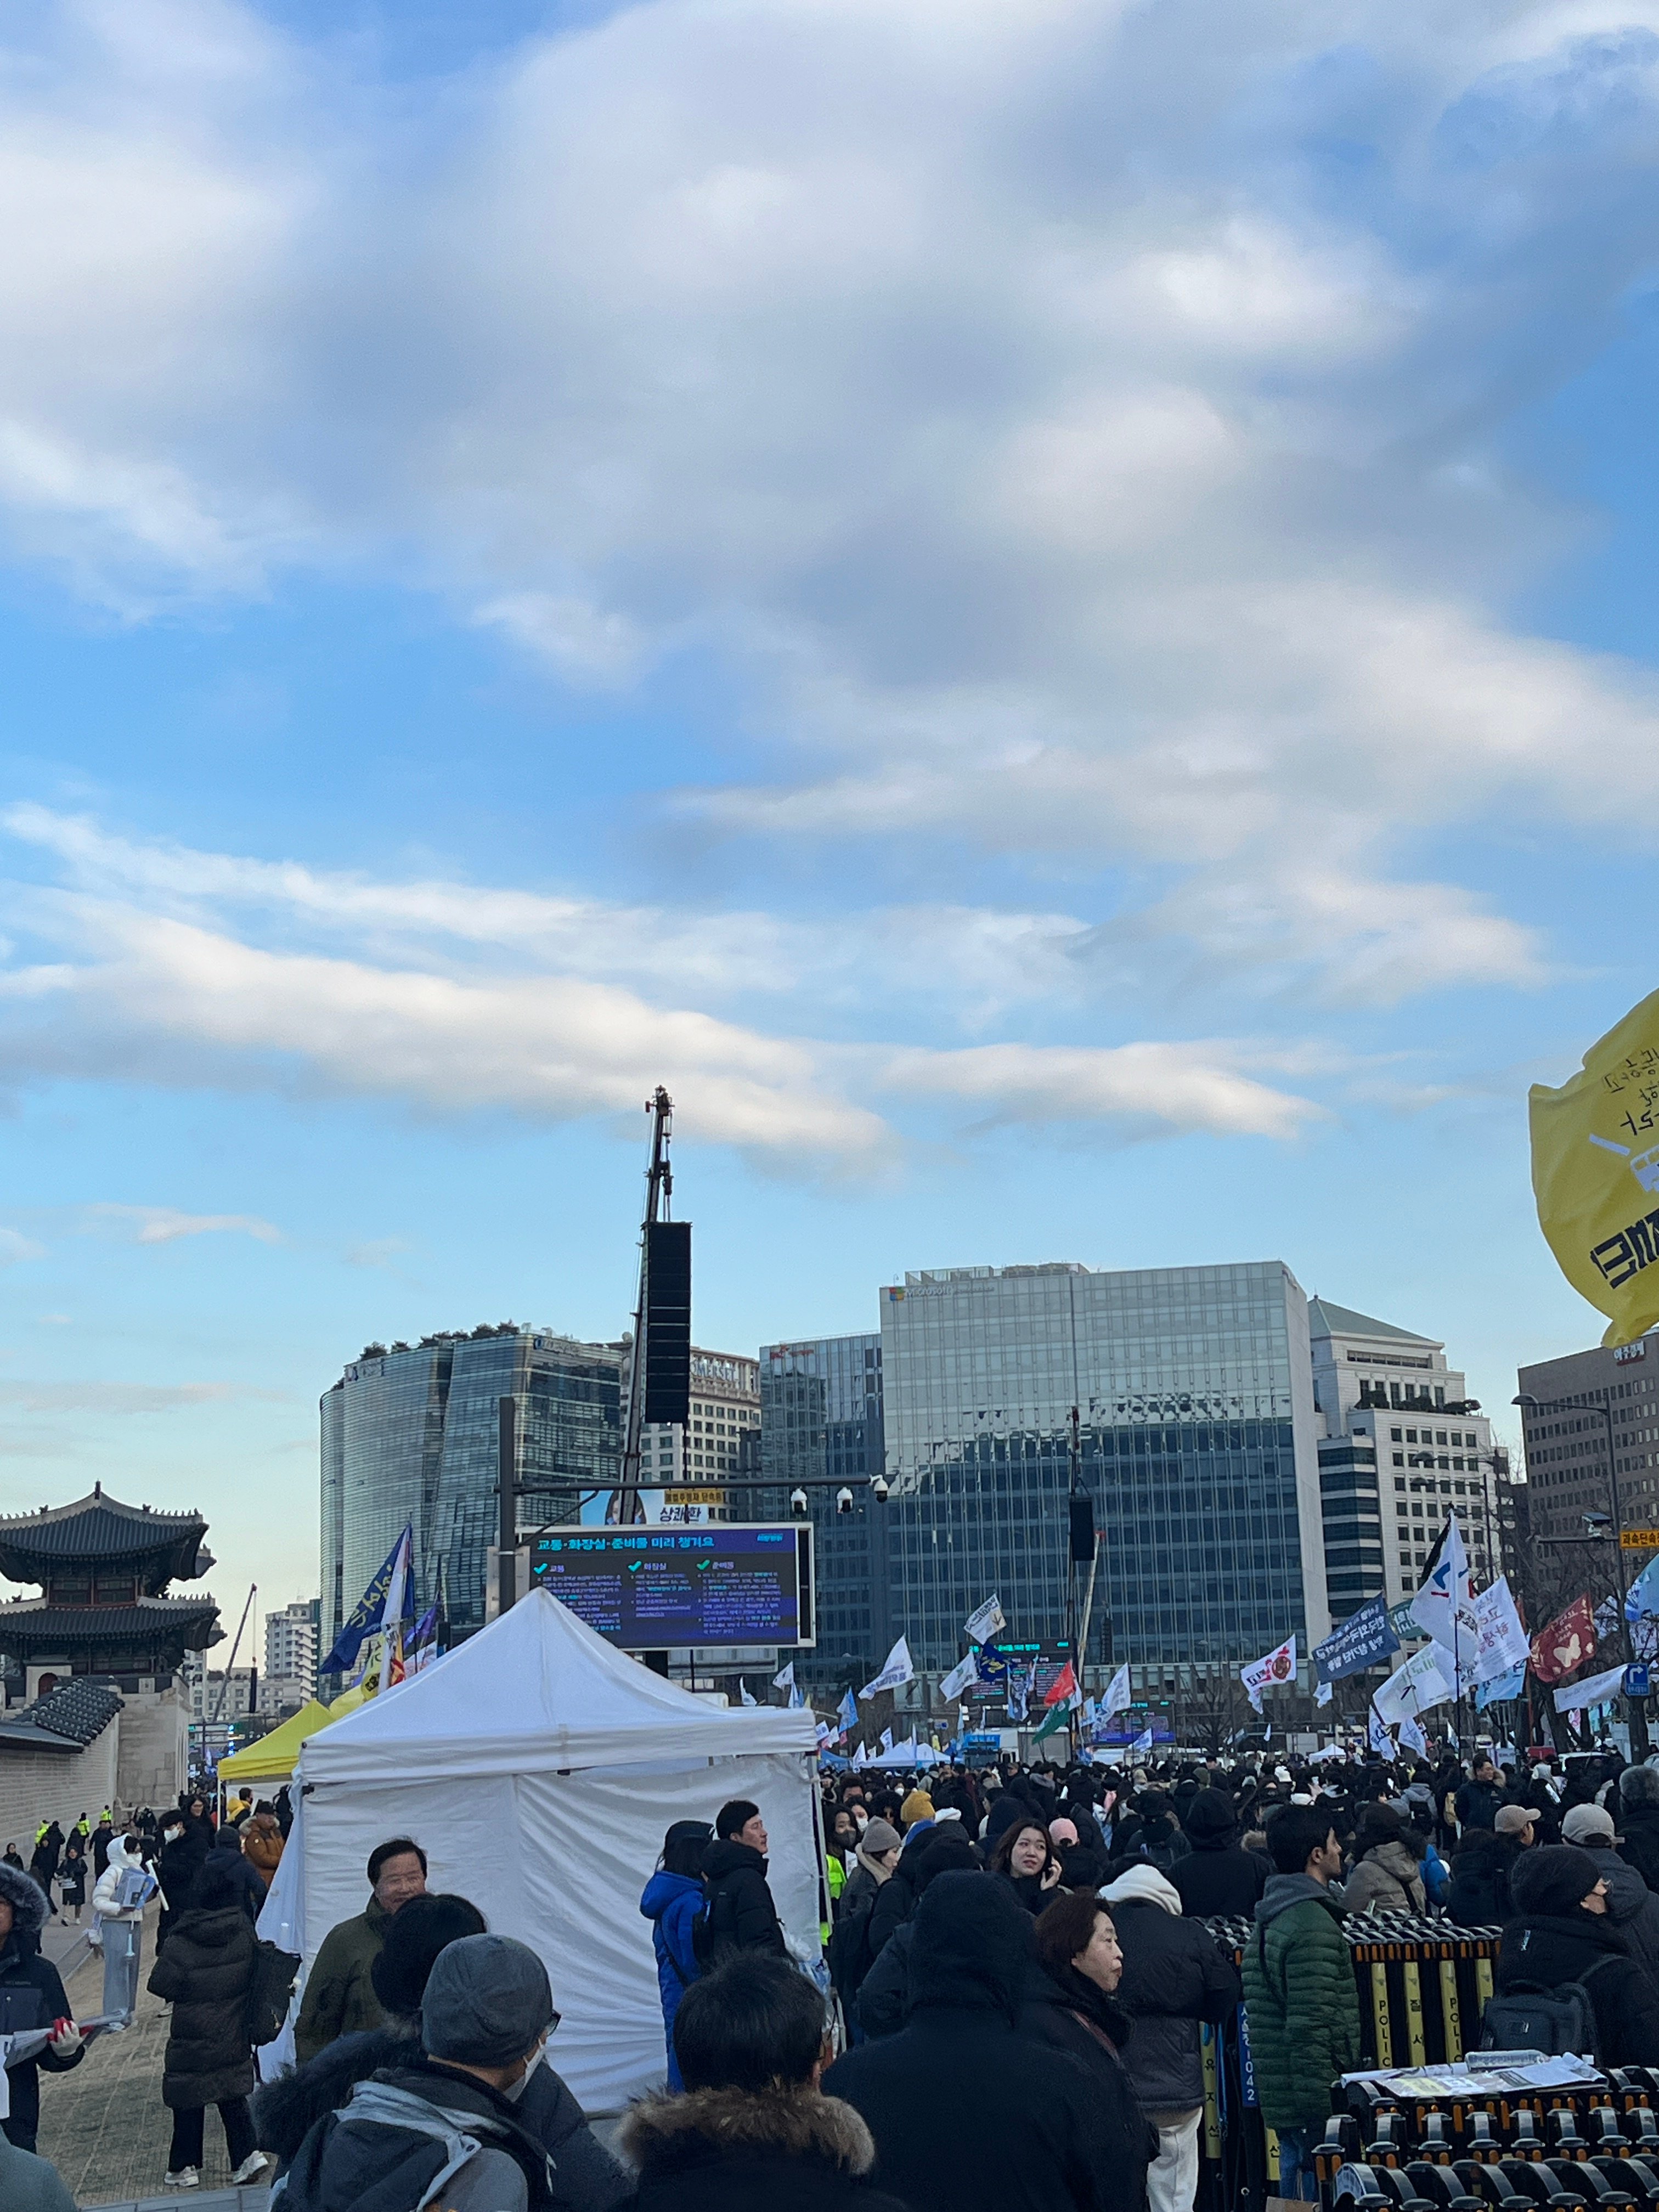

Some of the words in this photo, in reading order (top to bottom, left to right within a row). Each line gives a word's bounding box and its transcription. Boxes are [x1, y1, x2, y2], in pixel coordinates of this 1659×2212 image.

[906, 1285, 953, 1298] Microsoft
[651, 1536, 675, 1549] 미리
[1623, 1532, 1659, 1545] 과속단속
[1379, 2000, 1391, 2067] POLIC
[1449, 1997, 1463, 2063] POLIC
